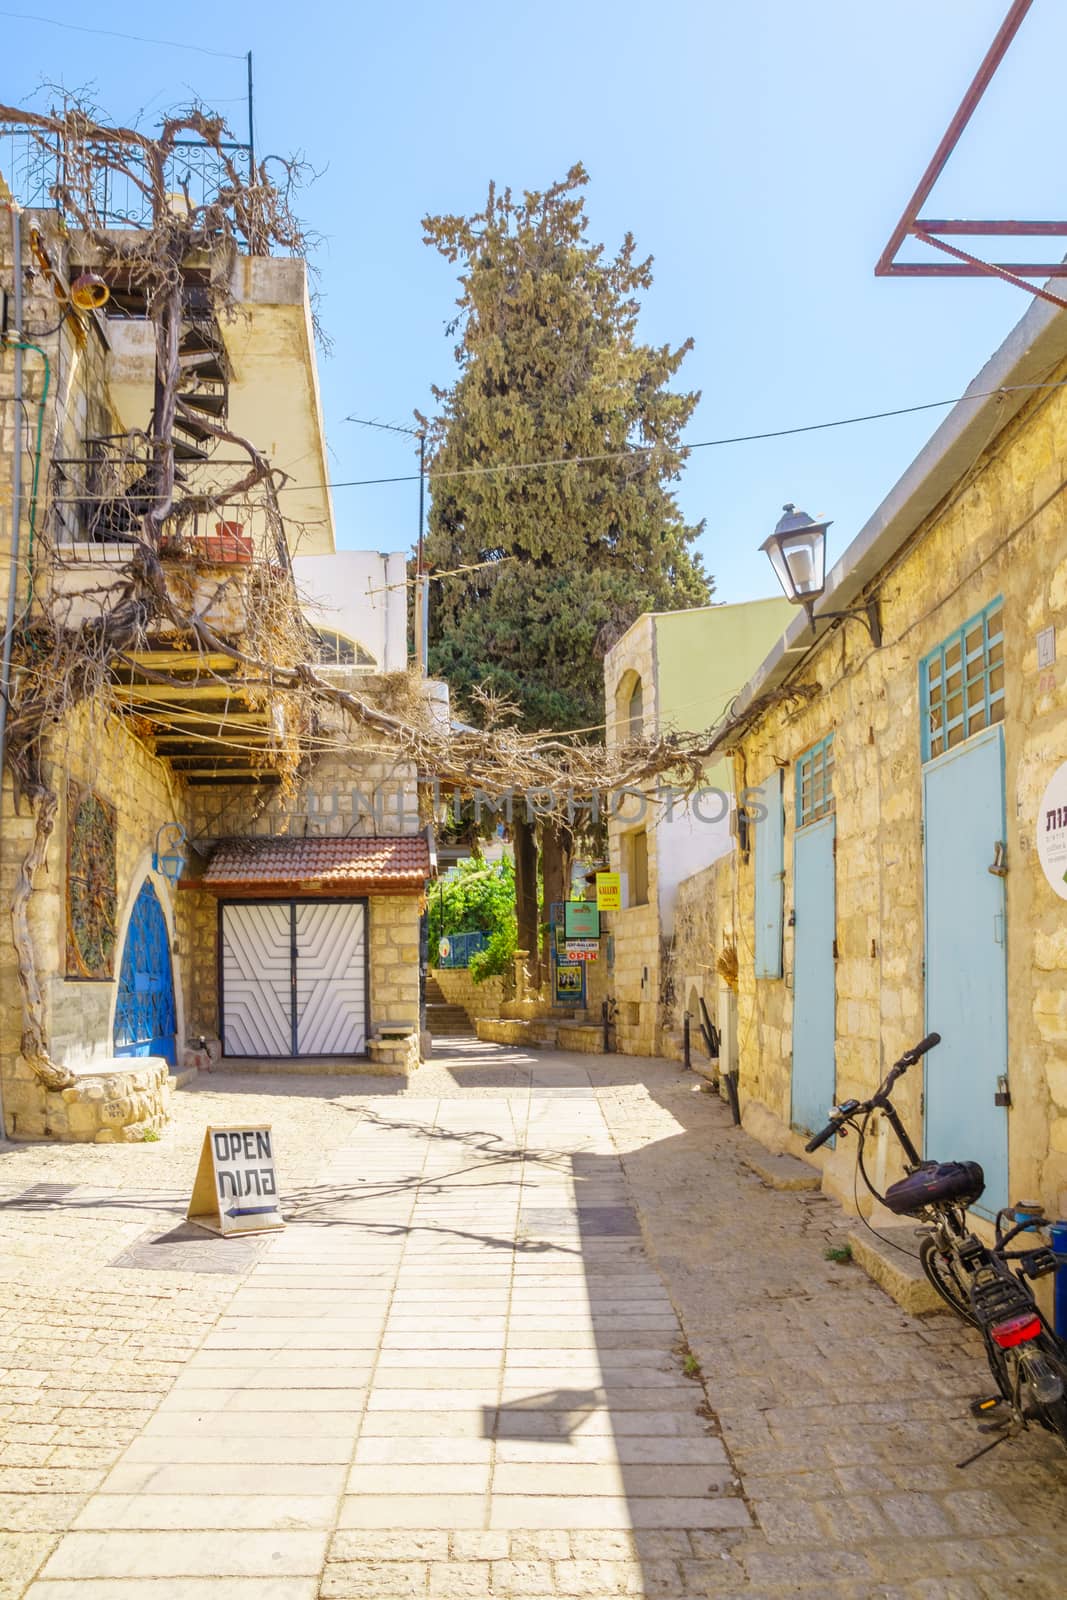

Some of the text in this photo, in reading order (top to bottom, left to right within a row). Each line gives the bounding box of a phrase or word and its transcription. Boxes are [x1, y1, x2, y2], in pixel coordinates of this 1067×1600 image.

[568, 951, 598, 961] OPEN
[214, 1131, 272, 1161] OPEN
[218, 1168, 276, 1198] פתוח
